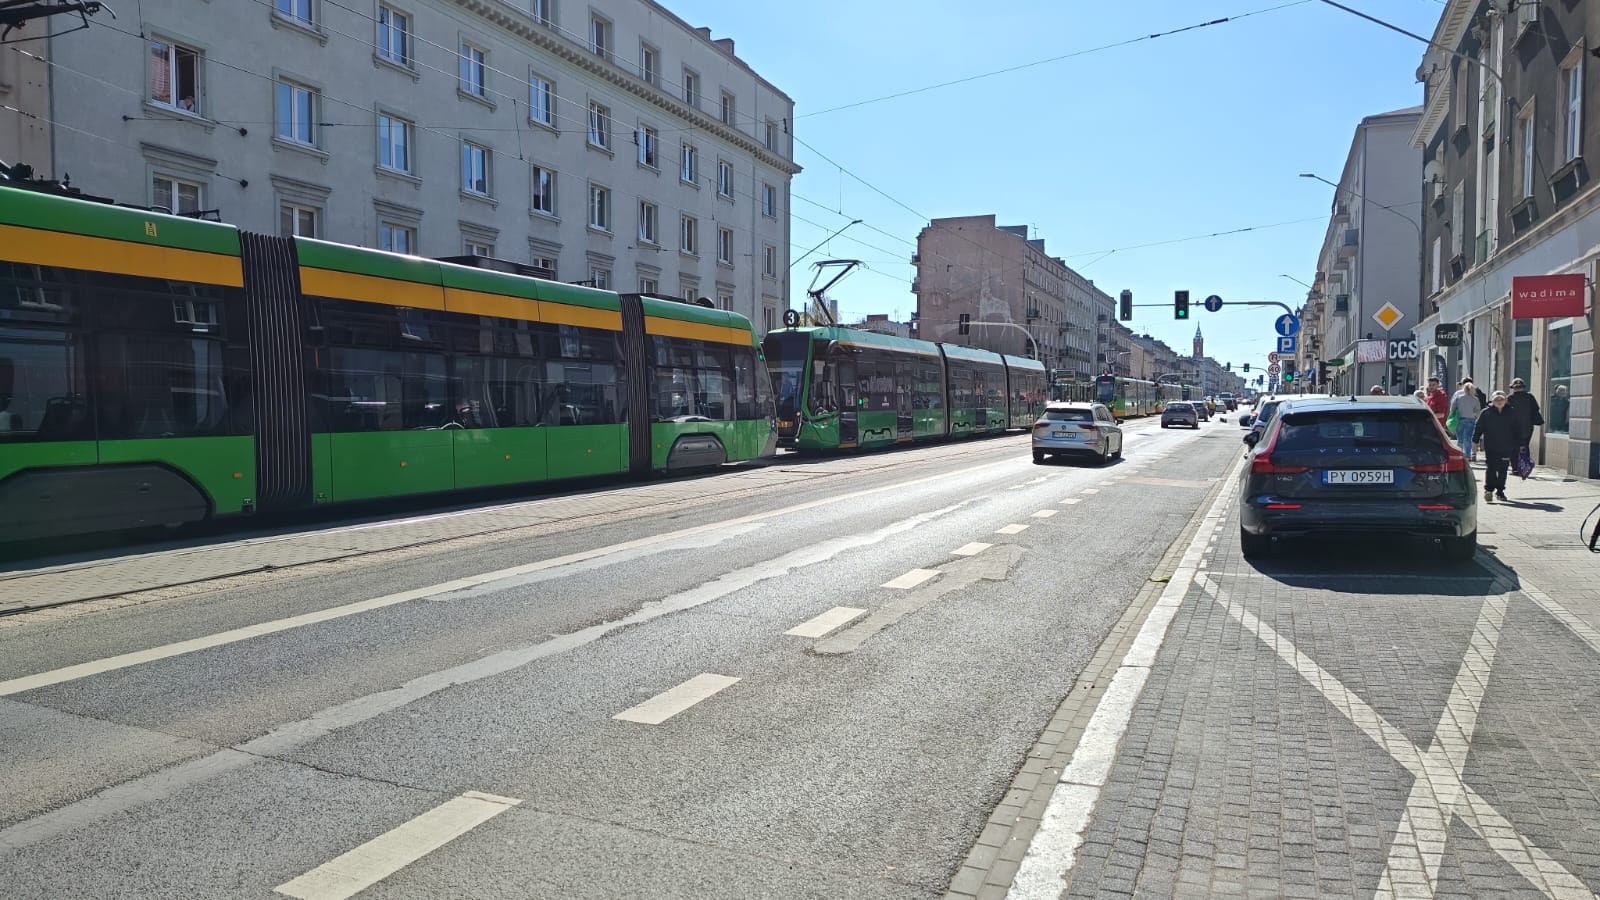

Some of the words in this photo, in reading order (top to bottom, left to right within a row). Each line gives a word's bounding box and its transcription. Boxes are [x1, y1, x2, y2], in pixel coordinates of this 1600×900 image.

[1519, 288, 1576, 298] wadima
[788, 312, 795, 325] 3
[1281, 338, 1292, 352] P
[1389, 340, 1418, 359] CCS
[1330, 471, 1346, 482] PY
[1351, 471, 1392, 482] 0959H
